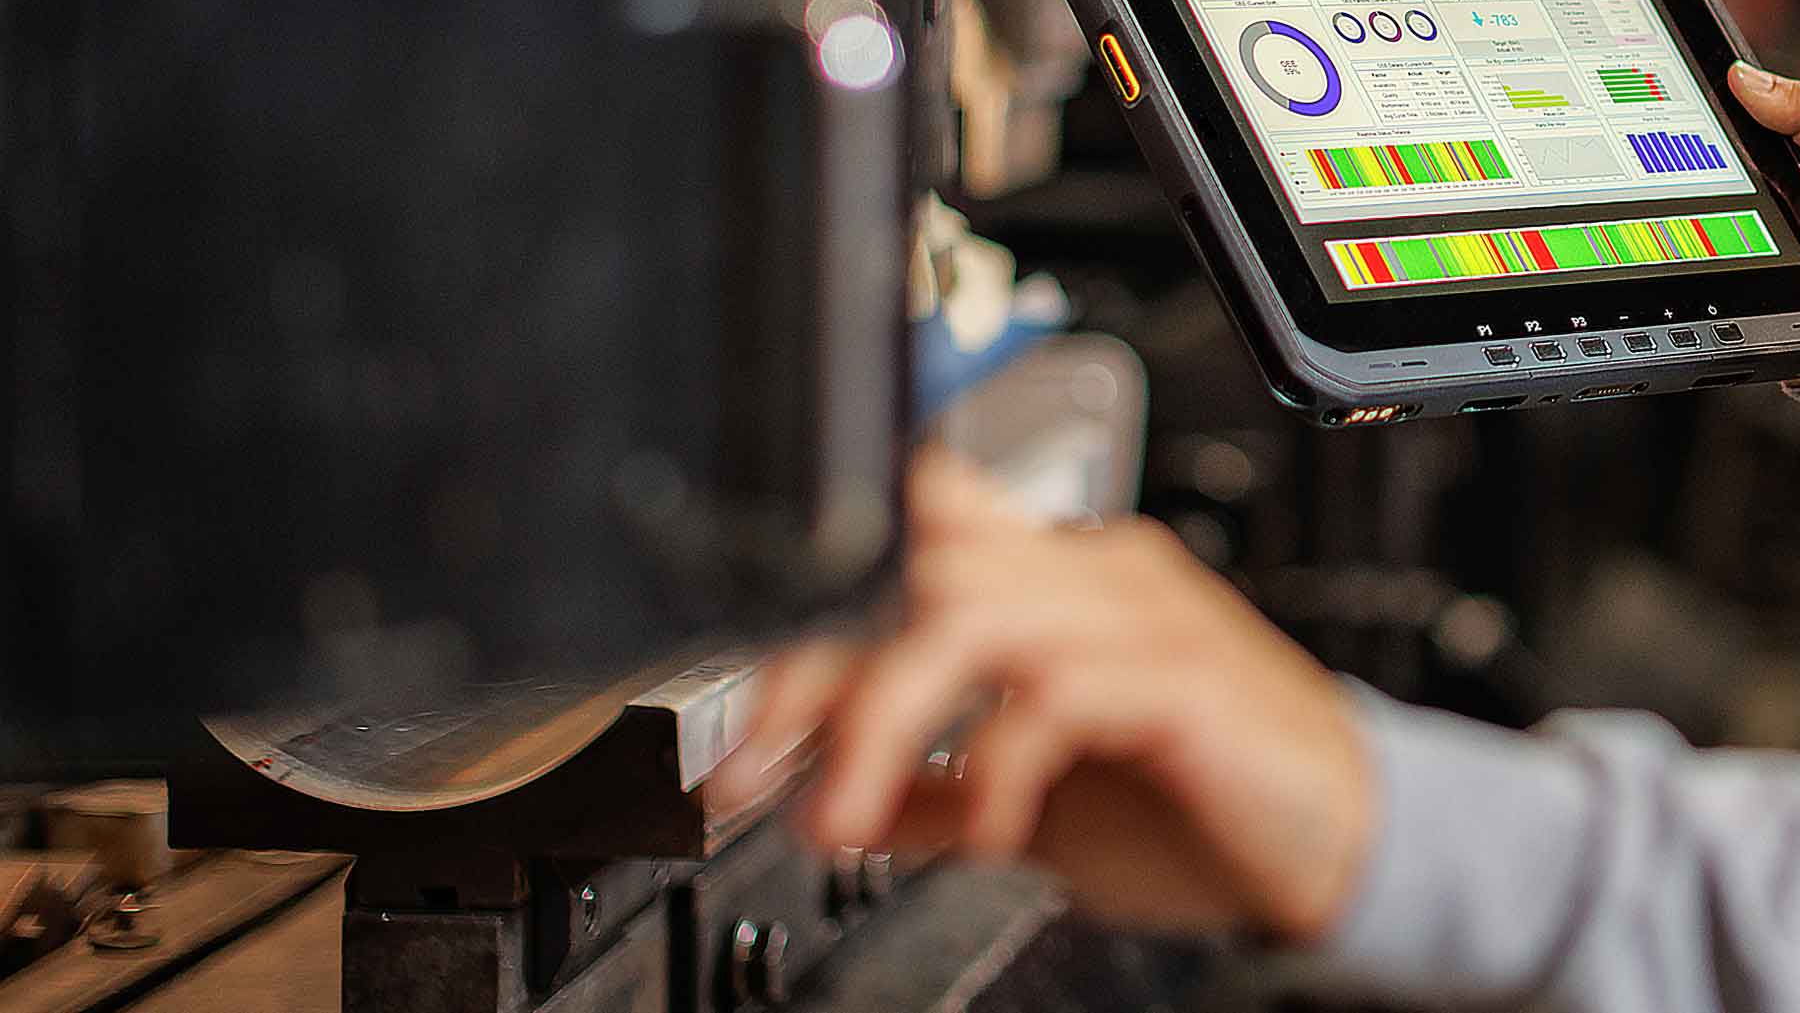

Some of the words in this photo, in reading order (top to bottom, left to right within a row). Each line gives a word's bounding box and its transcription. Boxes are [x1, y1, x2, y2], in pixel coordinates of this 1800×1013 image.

[1489, 13, 1519, 27] -783
[1477, 324, 1493, 336] P1
[1524, 320, 1542, 332] P2
[1571, 316, 1588, 328] P3
